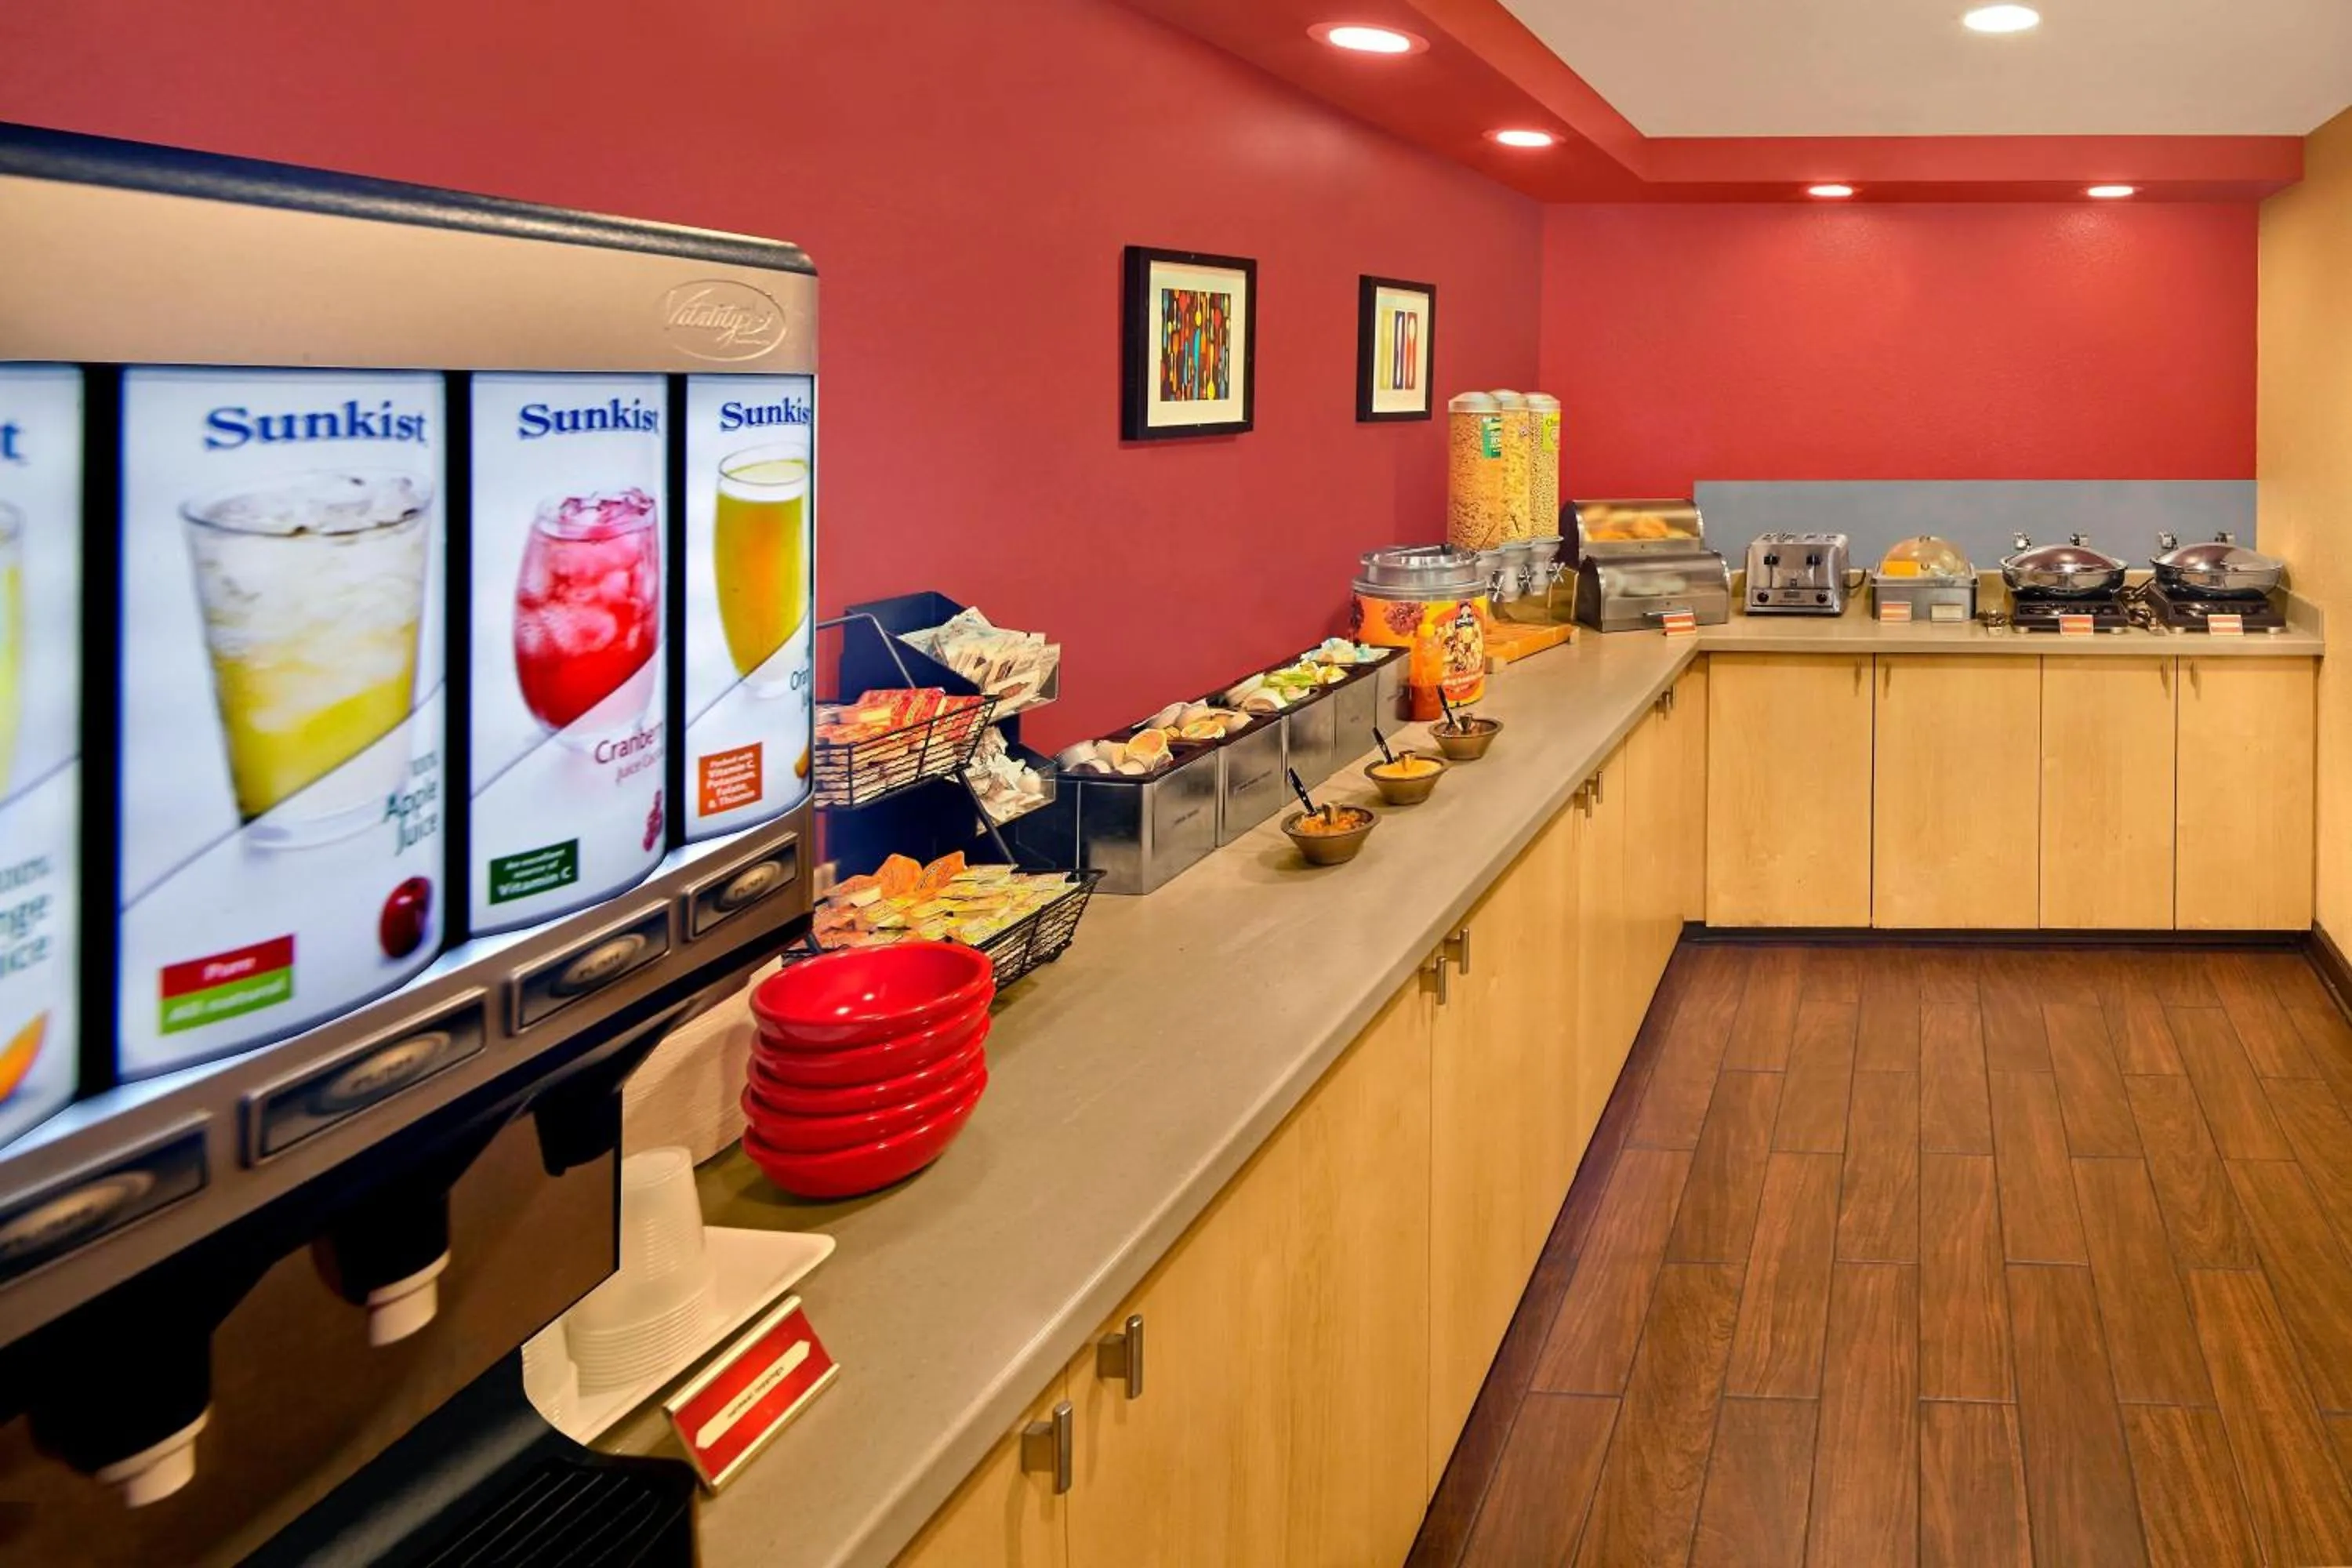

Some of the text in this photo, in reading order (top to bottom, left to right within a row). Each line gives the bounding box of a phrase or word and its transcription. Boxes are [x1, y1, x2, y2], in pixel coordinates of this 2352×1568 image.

[204, 400, 428, 450] Sunkist
[517, 397, 660, 440] Sunkist
[720, 397, 811, 431] Sunkis
[382, 781, 437, 823] Apple
[497, 865, 572, 896] Vitamin C
